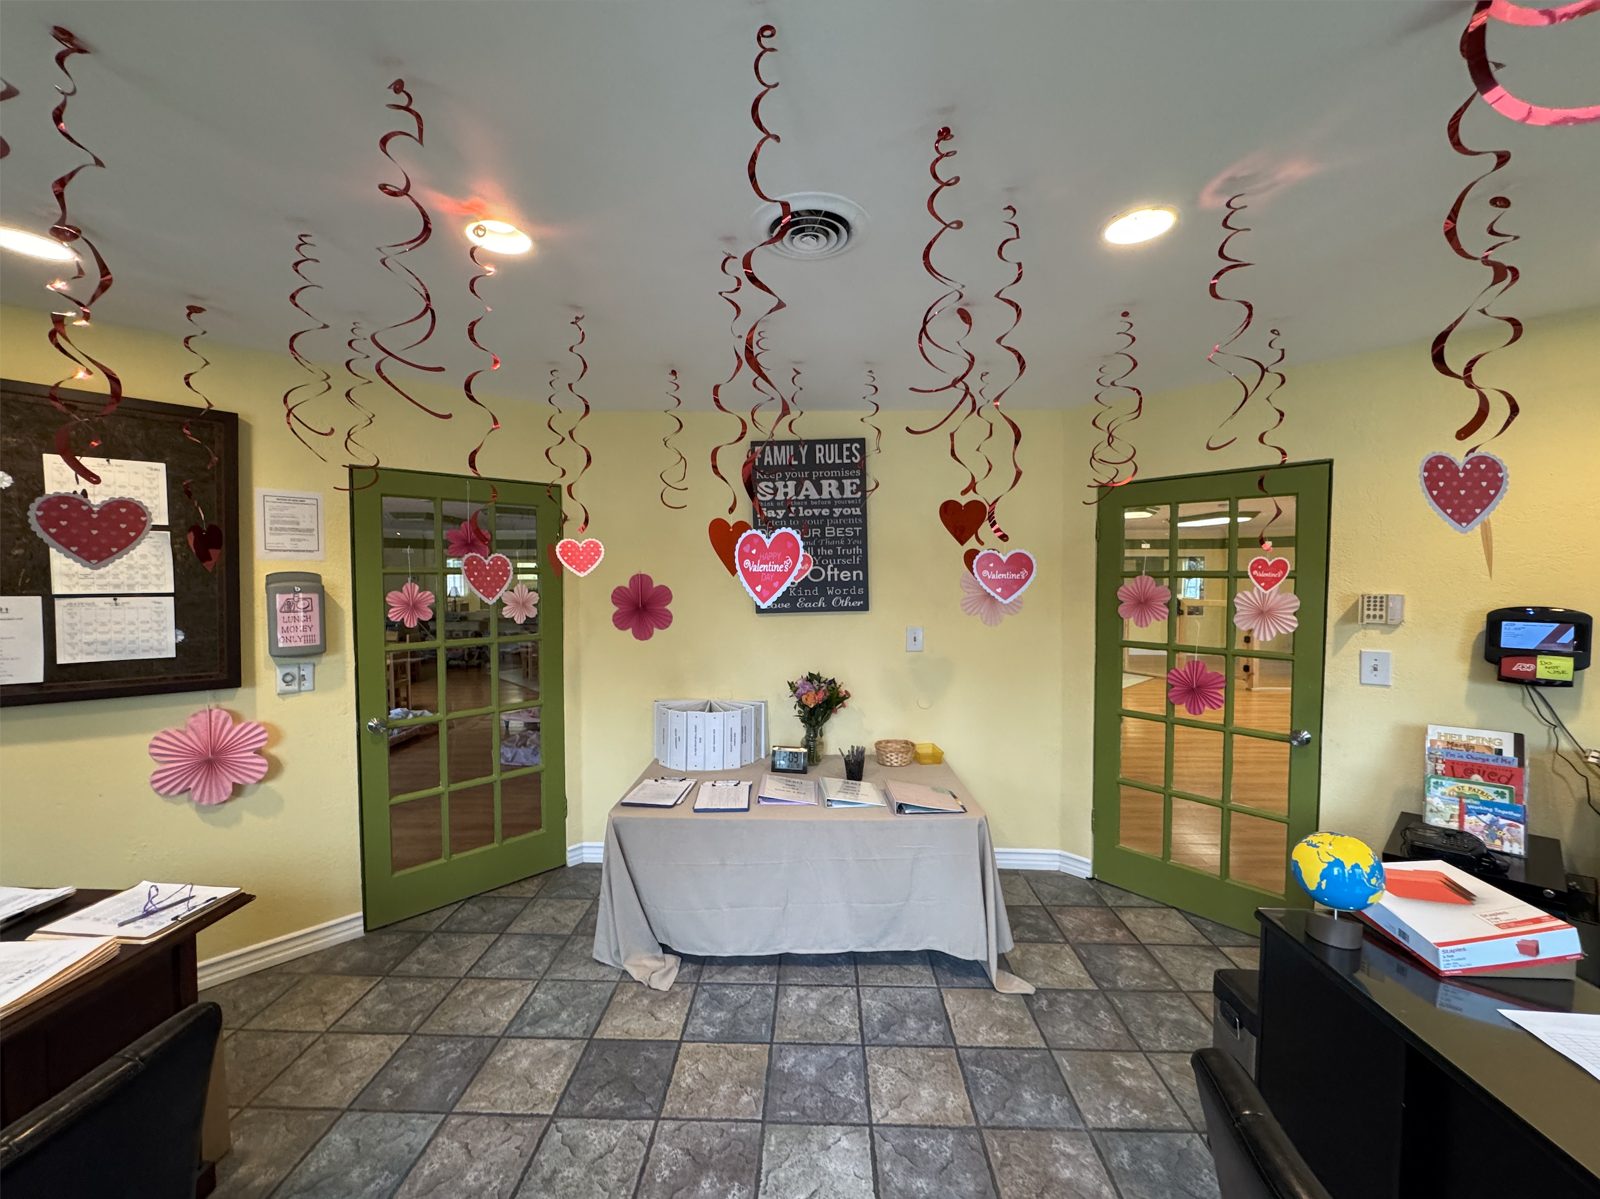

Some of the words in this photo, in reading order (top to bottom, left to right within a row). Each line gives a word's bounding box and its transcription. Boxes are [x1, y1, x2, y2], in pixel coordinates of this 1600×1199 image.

[755, 445, 808, 465] FAMILY
[815, 443, 861, 464] RULES
[785, 470, 809, 480] your
[812, 468, 861, 480] promises
[757, 480, 861, 500] SHARE
[798, 507, 830, 517] love
[832, 506, 862, 517] you
[790, 518, 799, 526] to
[826, 515, 863, 527] parents
[819, 537, 845, 545] Thank
[847, 537, 862, 545] You
[817, 547, 833, 556] the
[836, 546, 863, 556] Truth
[813, 555, 863, 566] Yourself
[808, 565, 863, 582] Often
[789, 588, 819, 596] Kind
[826, 586, 864, 596] Words
[796, 597, 827, 608] Each
[831, 596, 864, 607] Other
[282, 615, 312, 623] LUNCH
[281, 625, 313, 633] MONEY
[1512, 663, 1536, 672] ADP
[1437, 732, 1502, 746] HELPING
